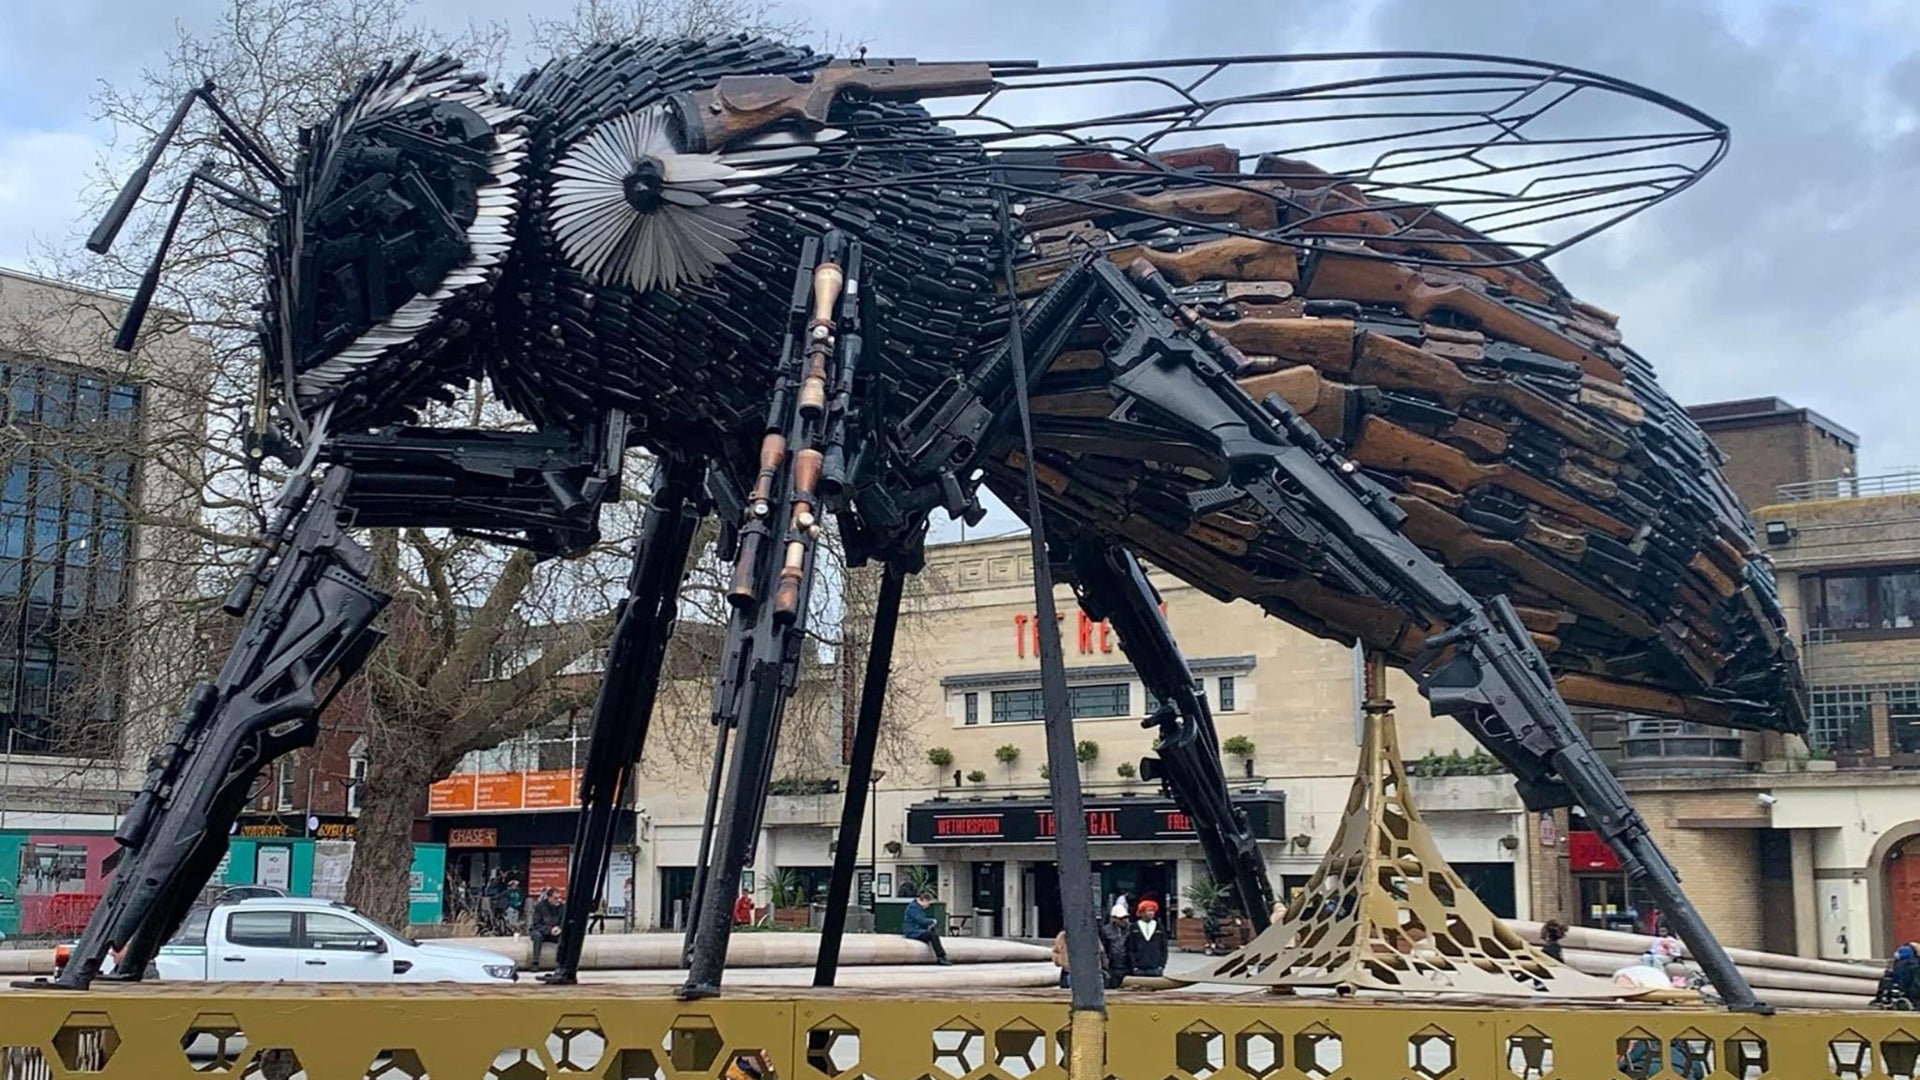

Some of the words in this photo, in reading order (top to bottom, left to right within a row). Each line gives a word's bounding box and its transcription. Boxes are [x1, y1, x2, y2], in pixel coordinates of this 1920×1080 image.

[937, 817, 1000, 835] WETHERSPOON
[1083, 812, 1117, 835] GAL
[450, 829, 485, 842] CHASE
